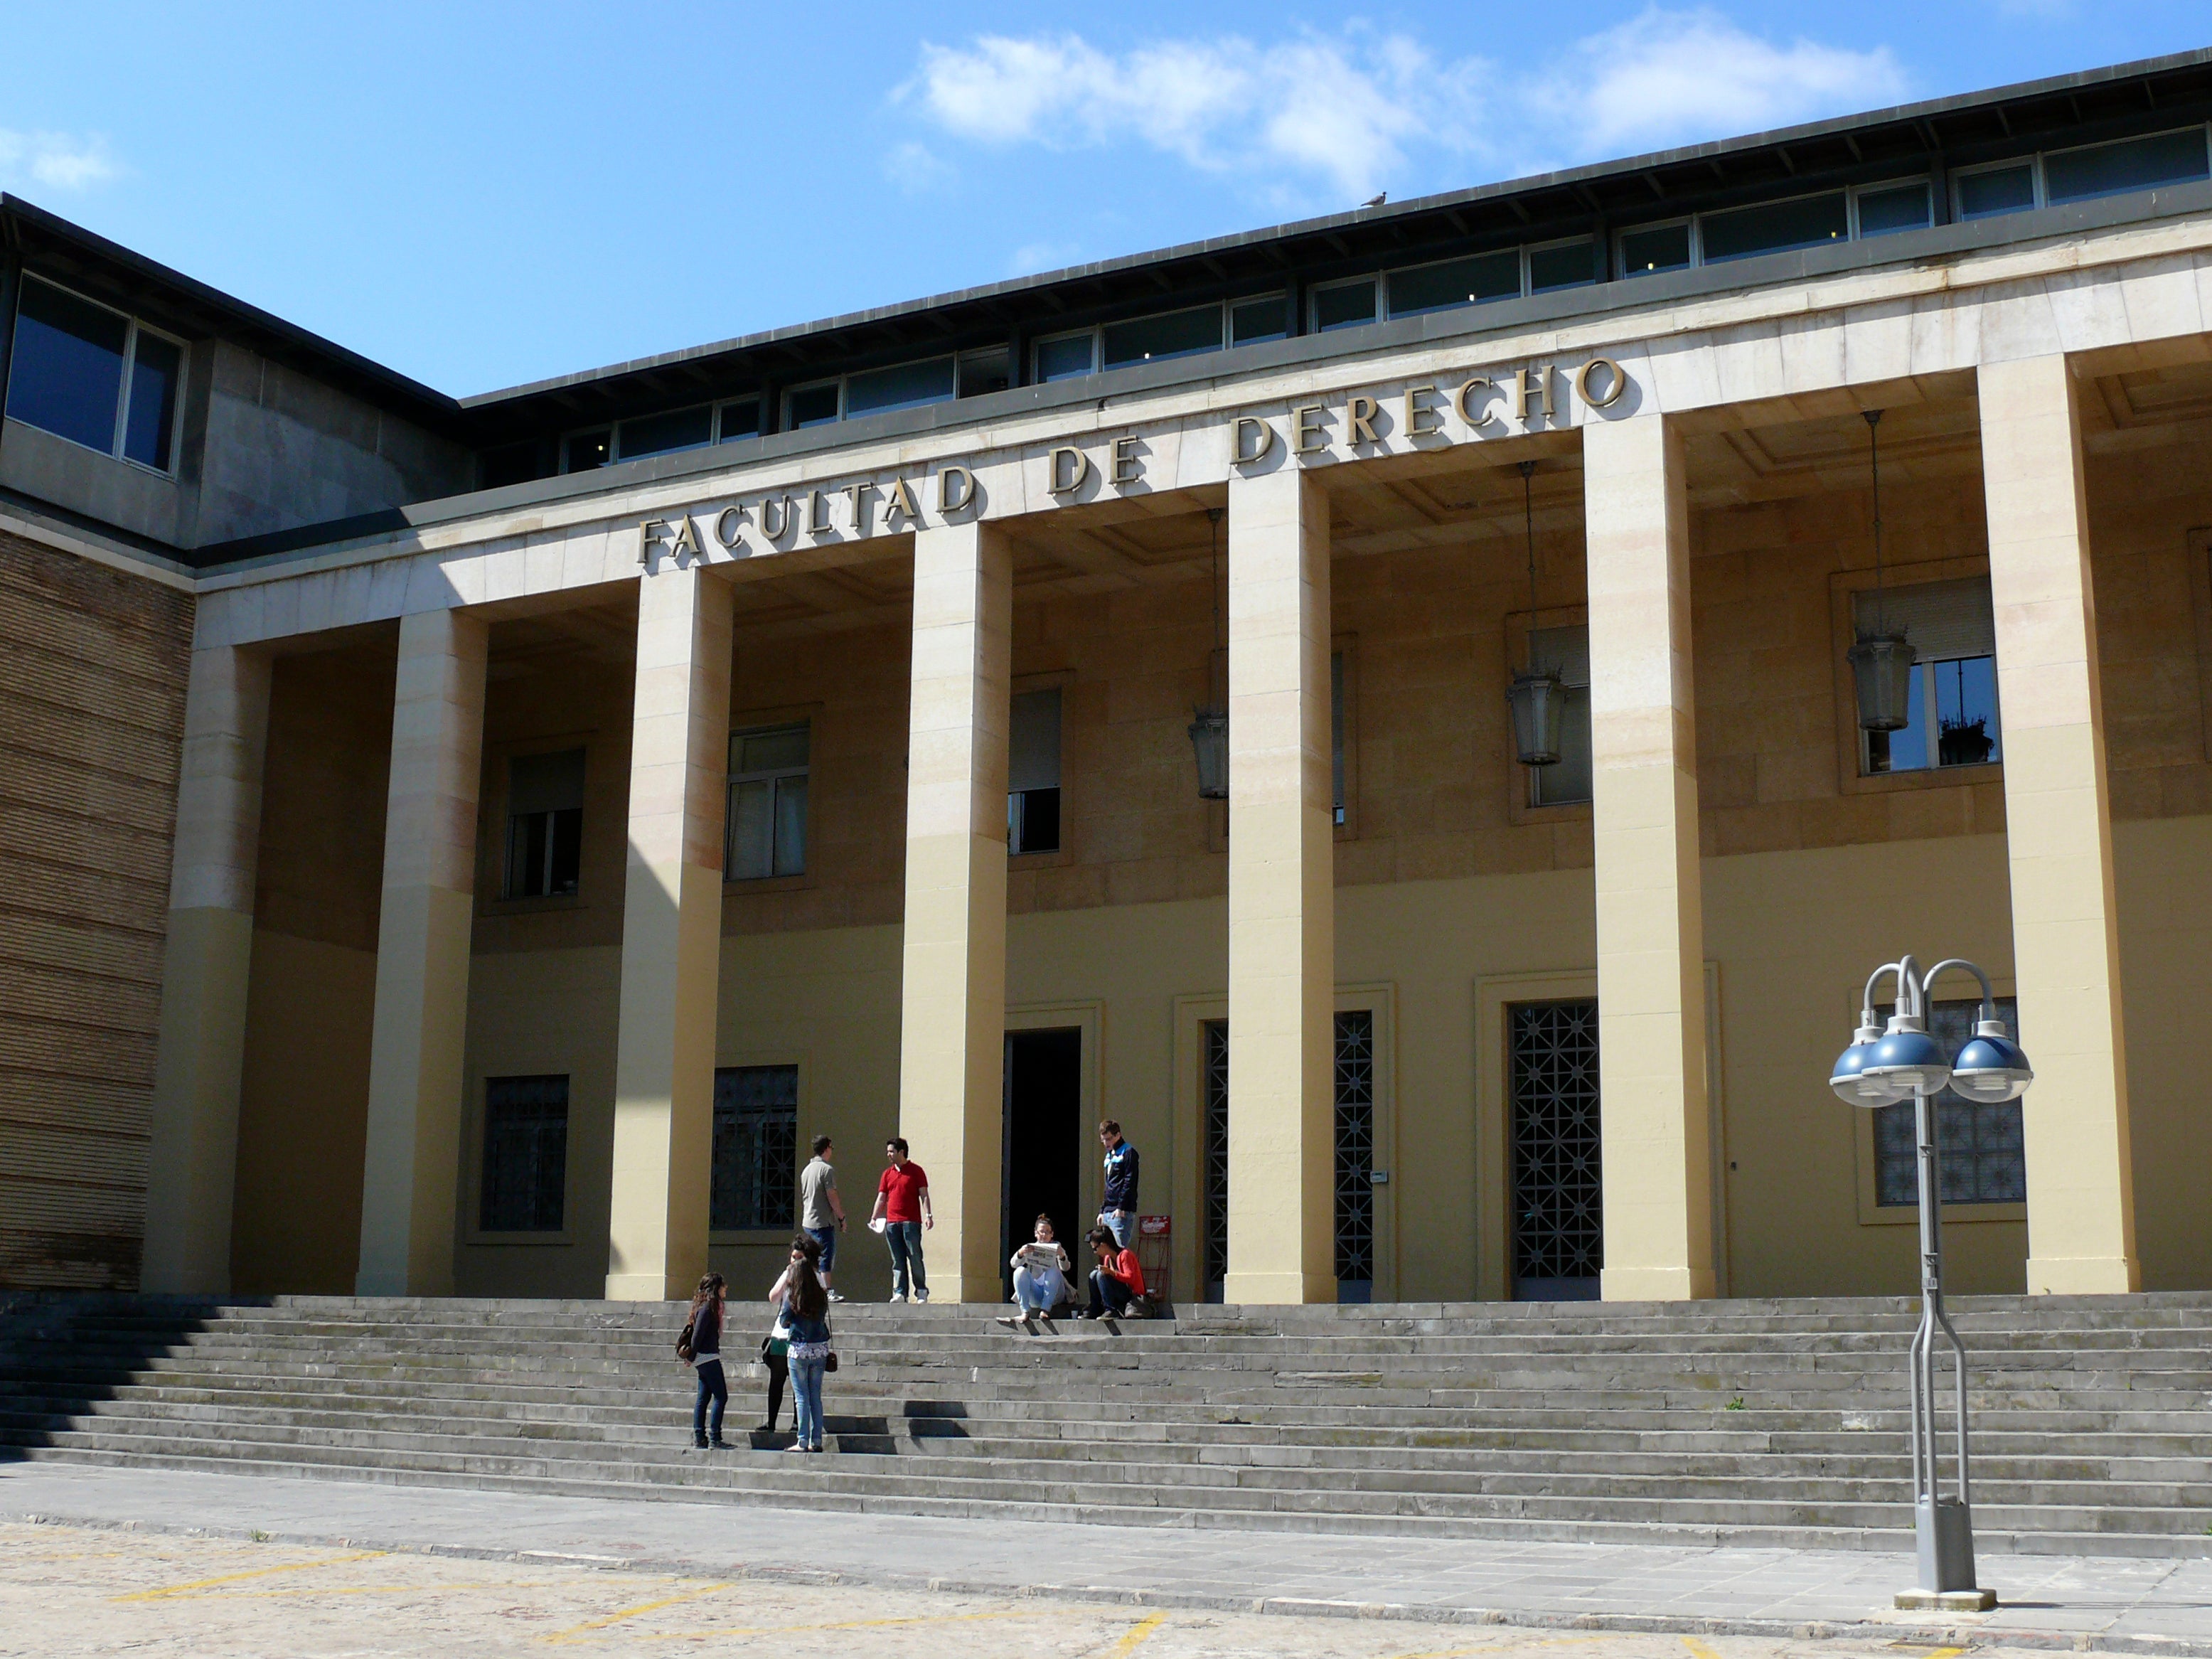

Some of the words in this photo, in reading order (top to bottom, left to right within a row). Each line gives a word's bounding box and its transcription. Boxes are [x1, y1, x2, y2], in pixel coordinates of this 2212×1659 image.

[638, 466, 976, 564] FACULTAD
[1047, 435, 1140, 494] DE
[1229, 358, 1625, 465] DERECHO
